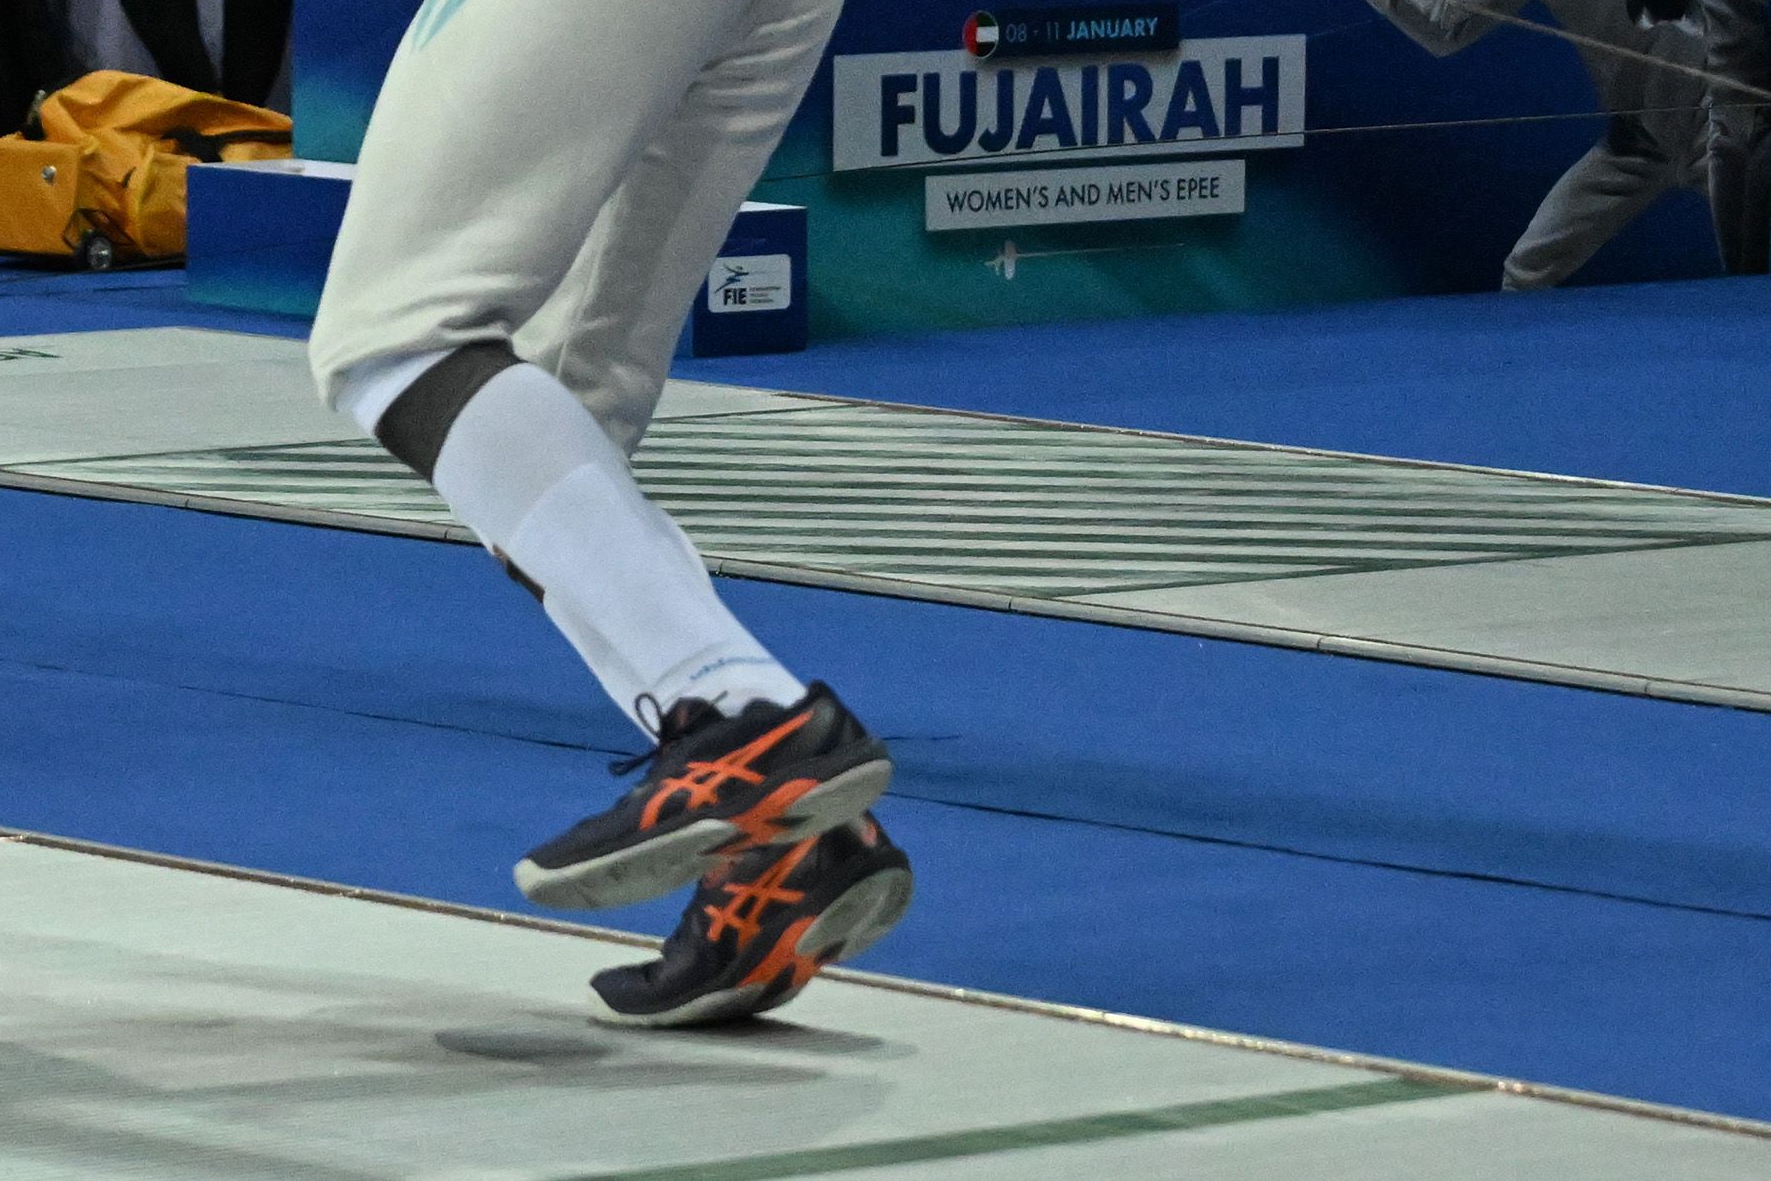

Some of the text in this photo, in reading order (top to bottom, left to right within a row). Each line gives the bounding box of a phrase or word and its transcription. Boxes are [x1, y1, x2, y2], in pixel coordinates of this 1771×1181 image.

[1005, 22, 1028, 44] 08
[1066, 17, 1159, 41] JANUARY
[880, 56, 1280, 157] FUJAIRAH
[946, 176, 1221, 213] WOMEN'S AND MEN'S EPEE
[723, 287, 747, 306] FIE
